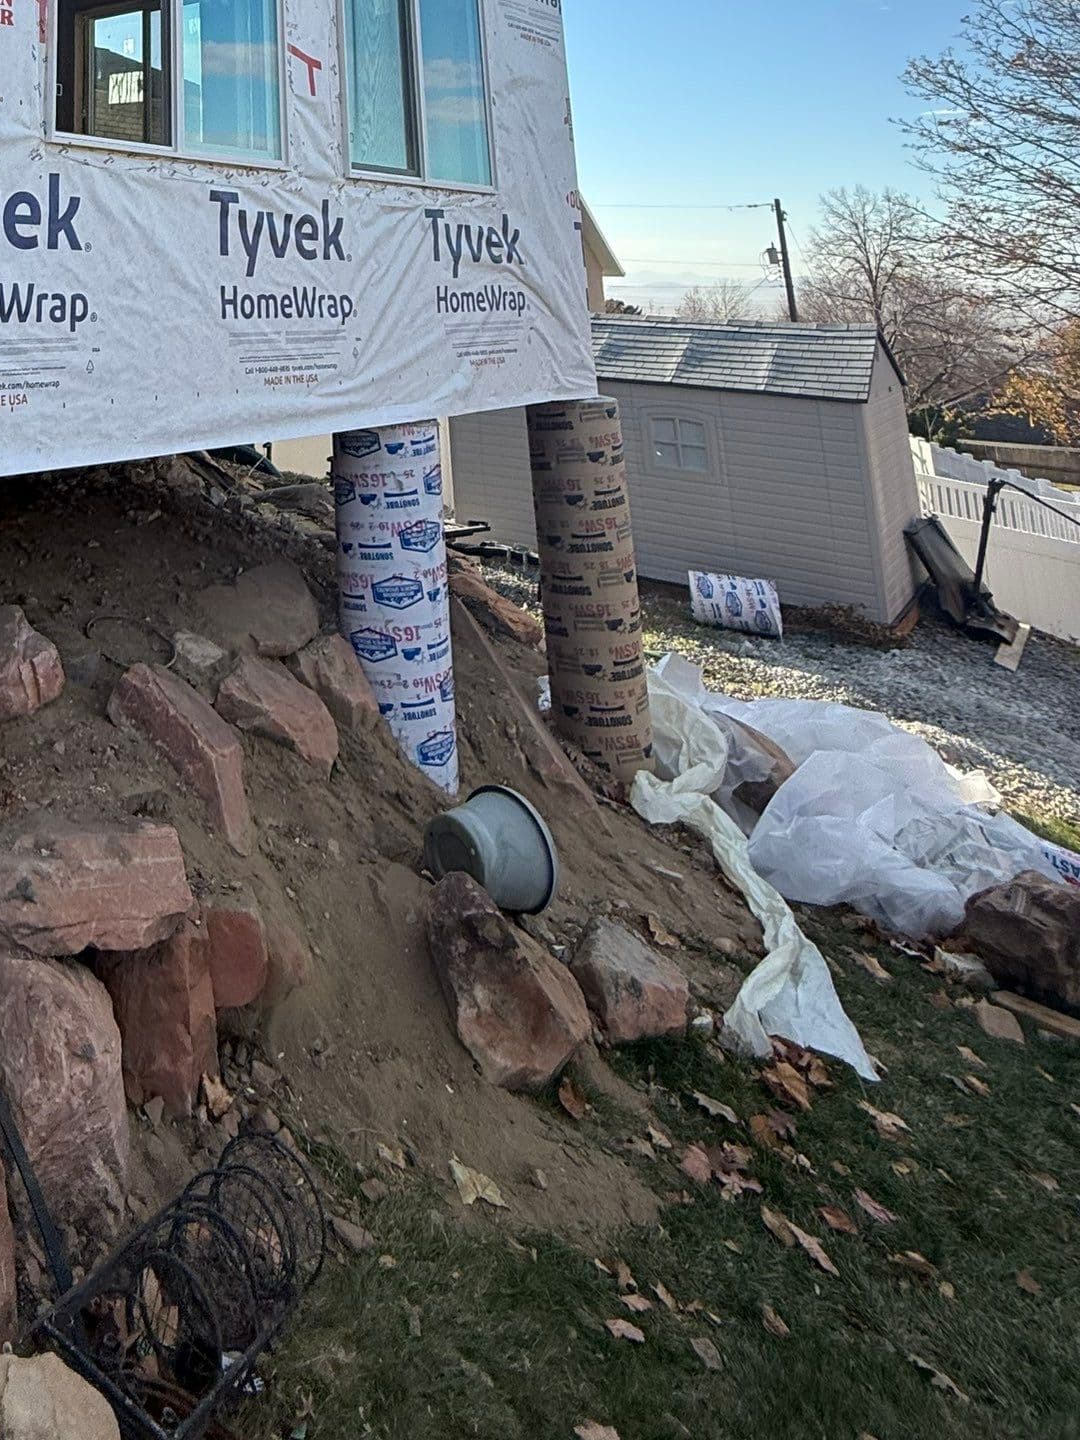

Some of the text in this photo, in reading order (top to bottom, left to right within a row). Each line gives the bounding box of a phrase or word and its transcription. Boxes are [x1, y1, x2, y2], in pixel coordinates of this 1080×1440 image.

[209, 190, 345, 277] Tyvek
[424, 209, 525, 278] Tyvek
[220, 285, 354, 325] HomeWrap
[436, 284, 527, 317] HomeWrap
[9, 394, 28, 407] USA
